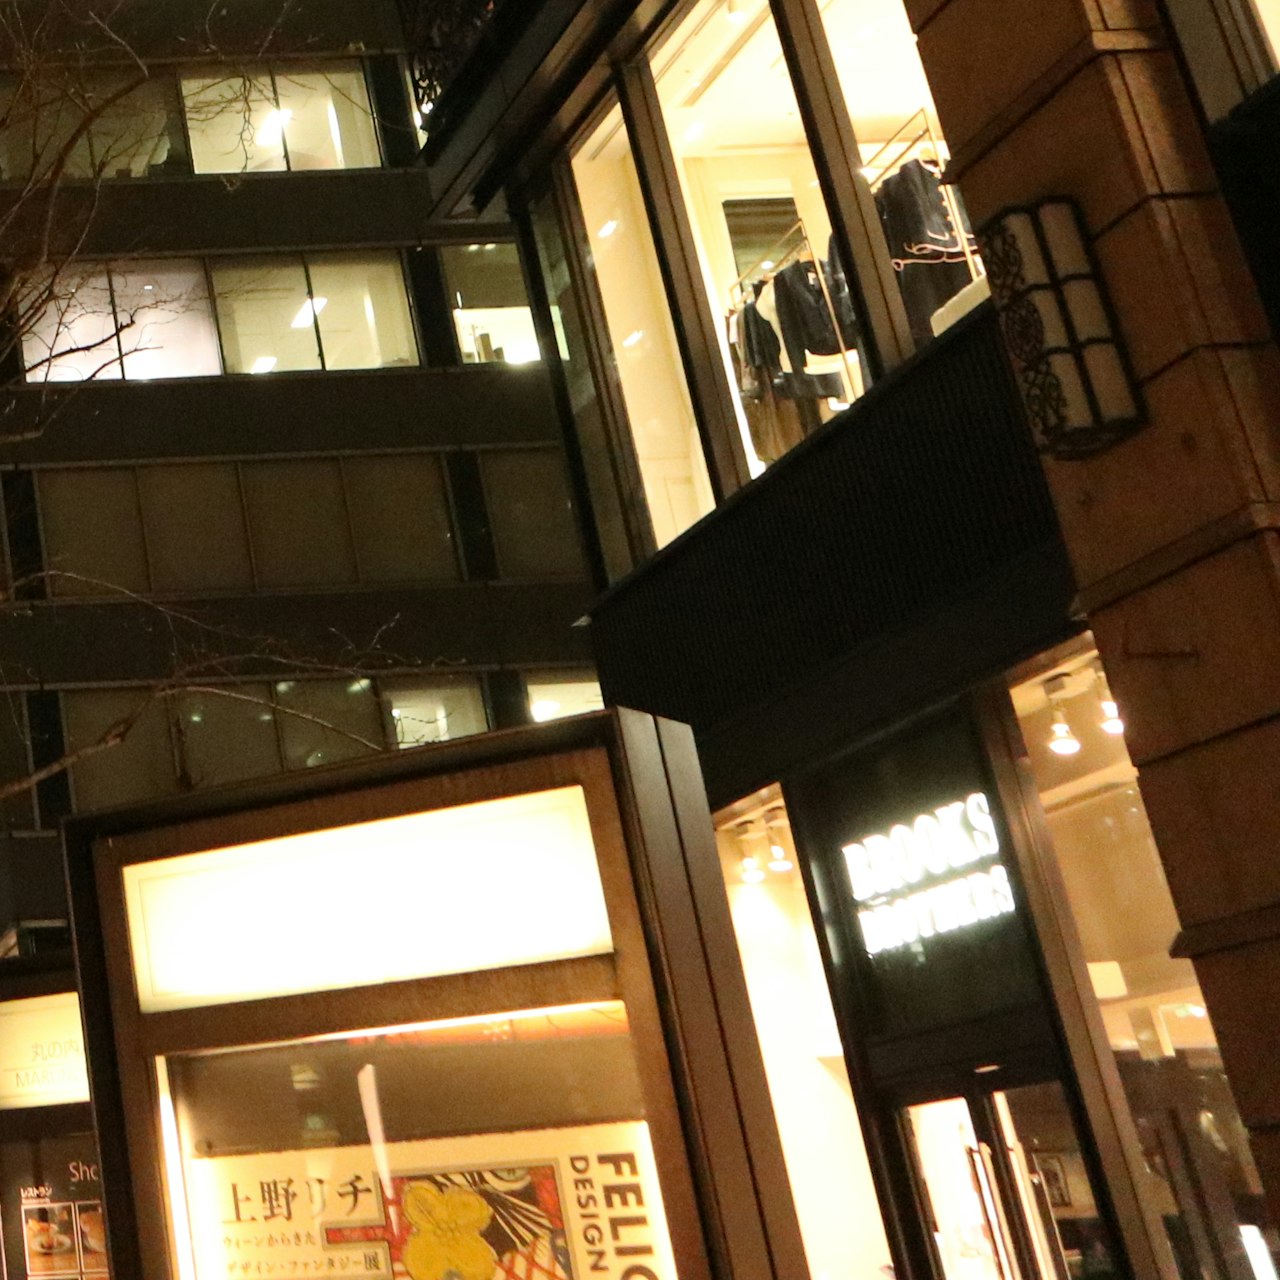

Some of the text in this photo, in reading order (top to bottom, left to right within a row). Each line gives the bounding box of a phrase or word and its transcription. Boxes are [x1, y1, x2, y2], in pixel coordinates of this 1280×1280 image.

[842, 793, 999, 901] BROOKS
[223, 1174, 373, 1223] 上野リチ
[570, 1155, 608, 1272] DESIGN
